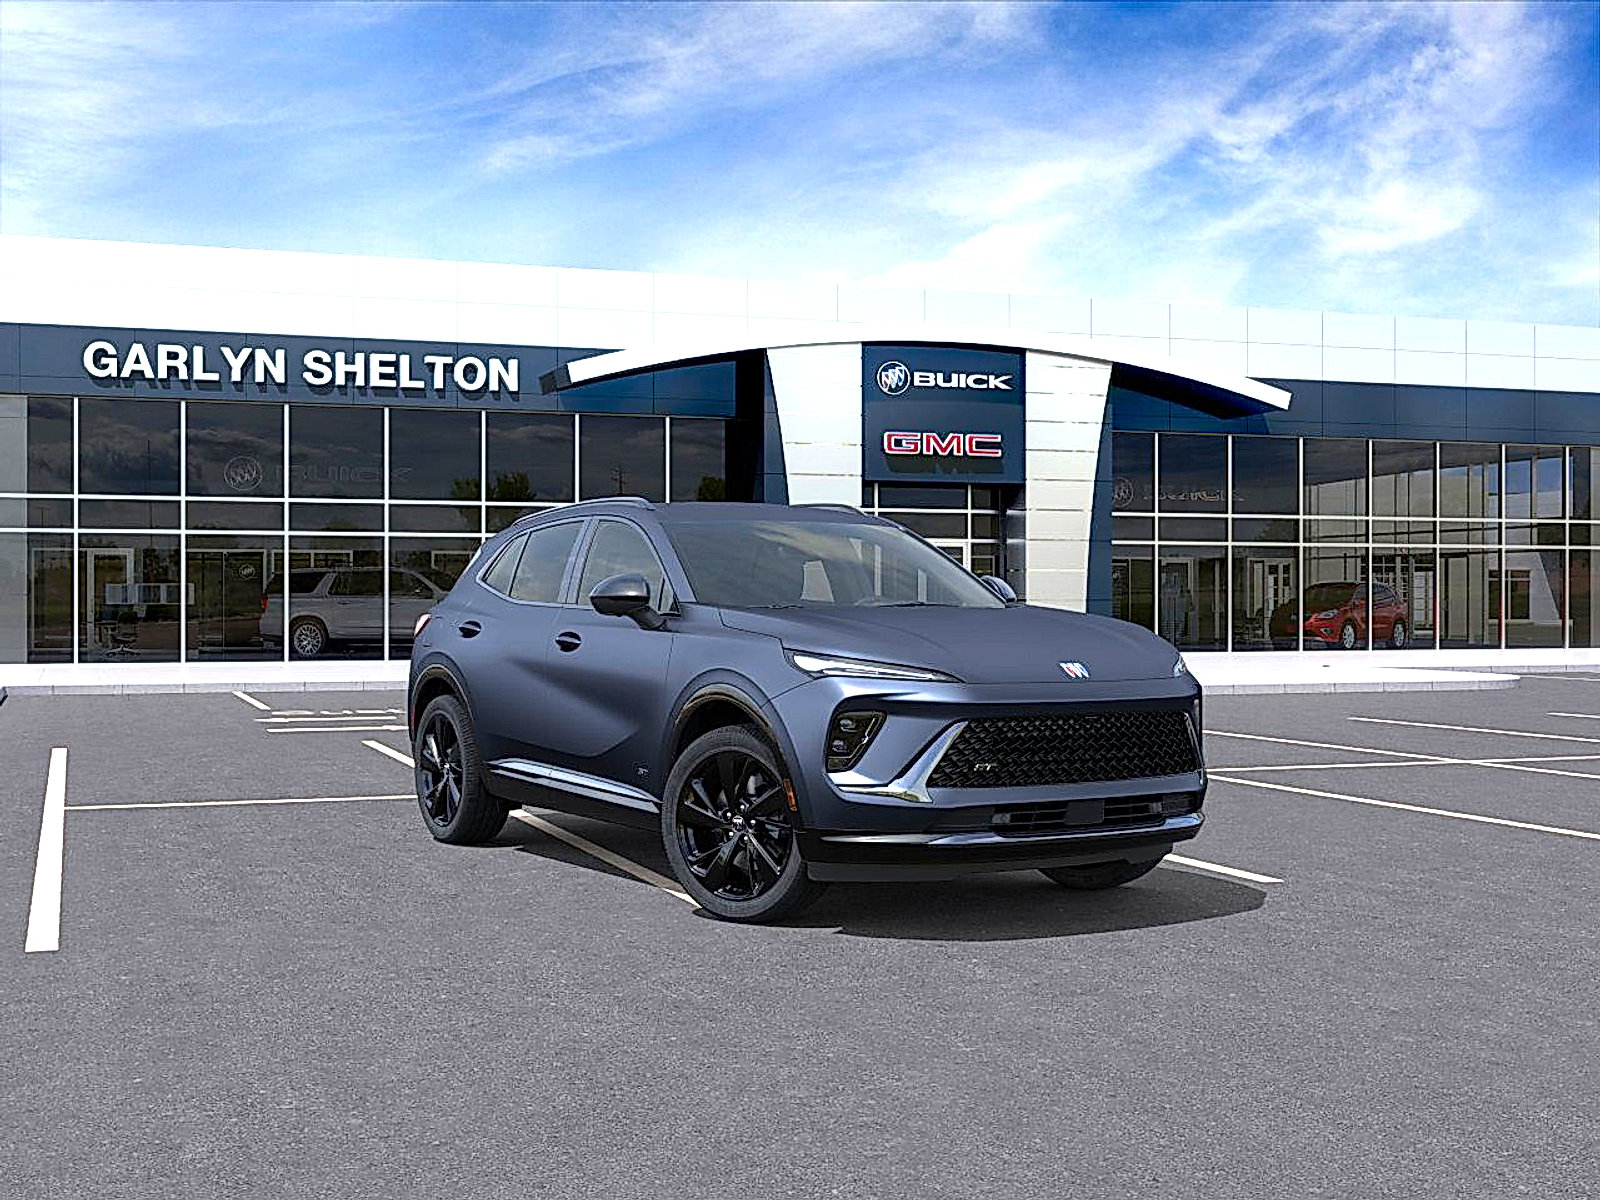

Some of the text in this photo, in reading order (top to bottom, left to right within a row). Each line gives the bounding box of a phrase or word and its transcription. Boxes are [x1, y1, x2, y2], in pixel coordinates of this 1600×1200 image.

[82, 341, 520, 392] GARLYN SHELTON
[913, 371, 1013, 391] BUICK
[883, 430, 1003, 458] GMC
